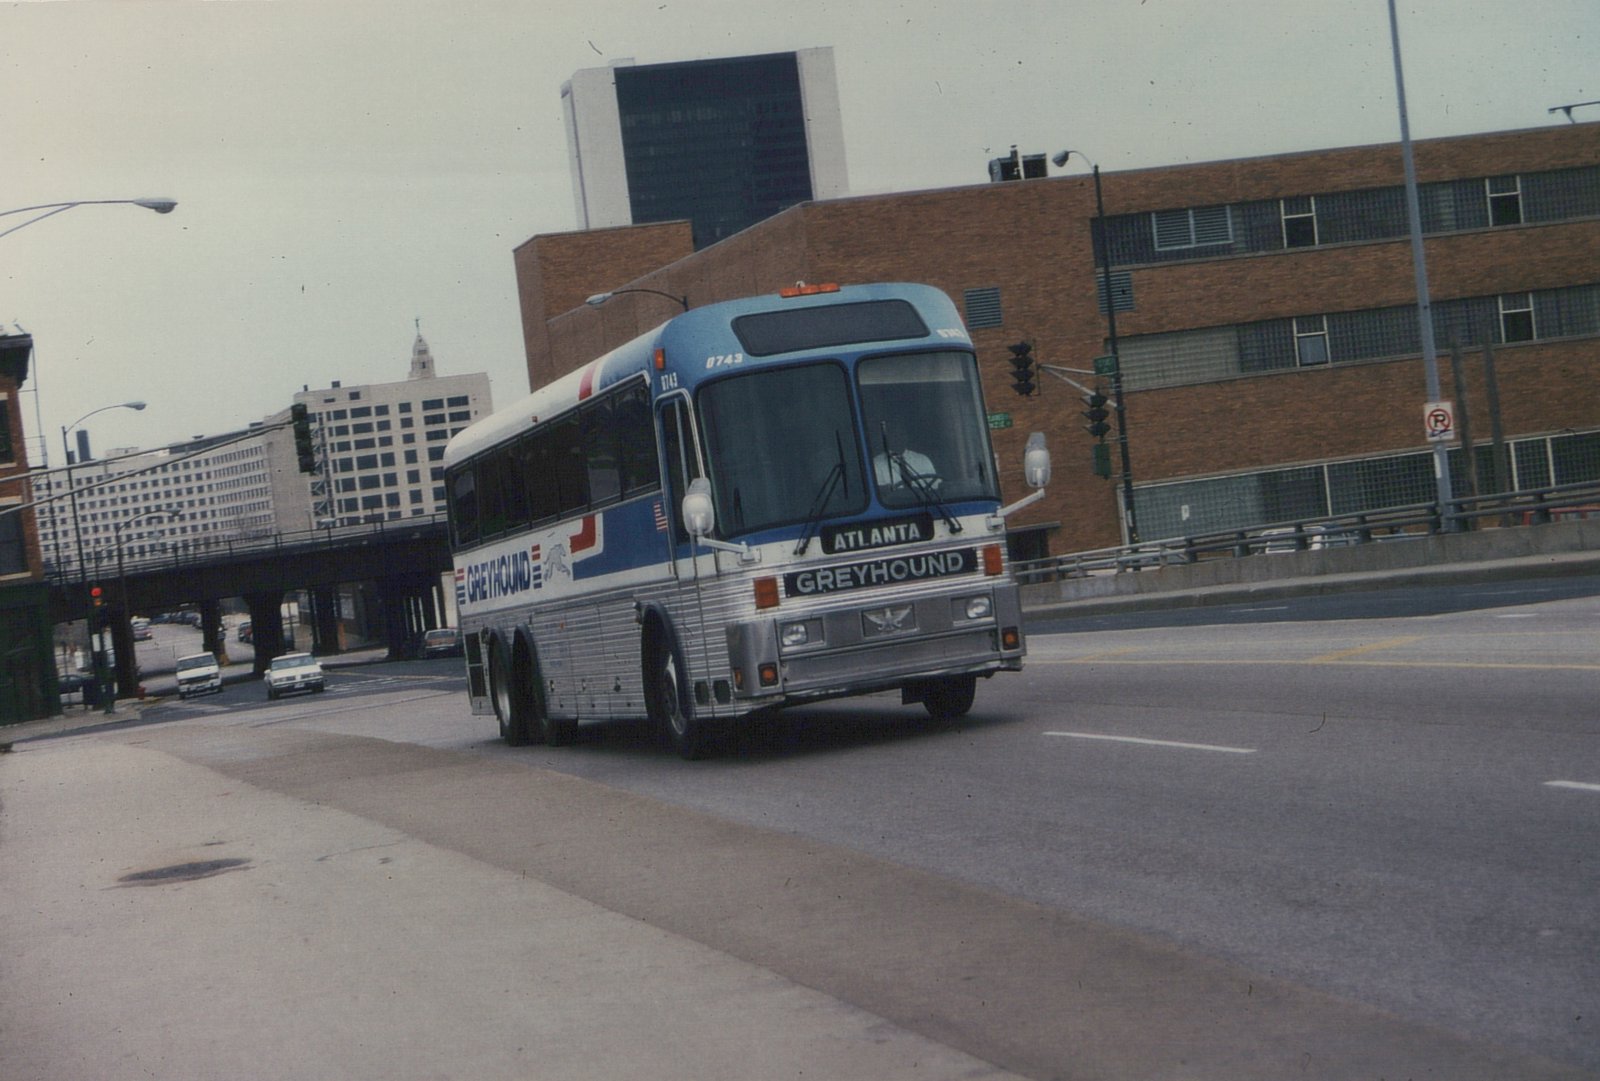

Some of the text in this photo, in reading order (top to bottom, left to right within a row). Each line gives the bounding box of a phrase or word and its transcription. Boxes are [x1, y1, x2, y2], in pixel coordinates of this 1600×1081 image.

[834, 522, 921, 551] ATLANTA
[467, 550, 531, 604] GREYHOUND
[796, 551, 964, 593] GREYHOUND
